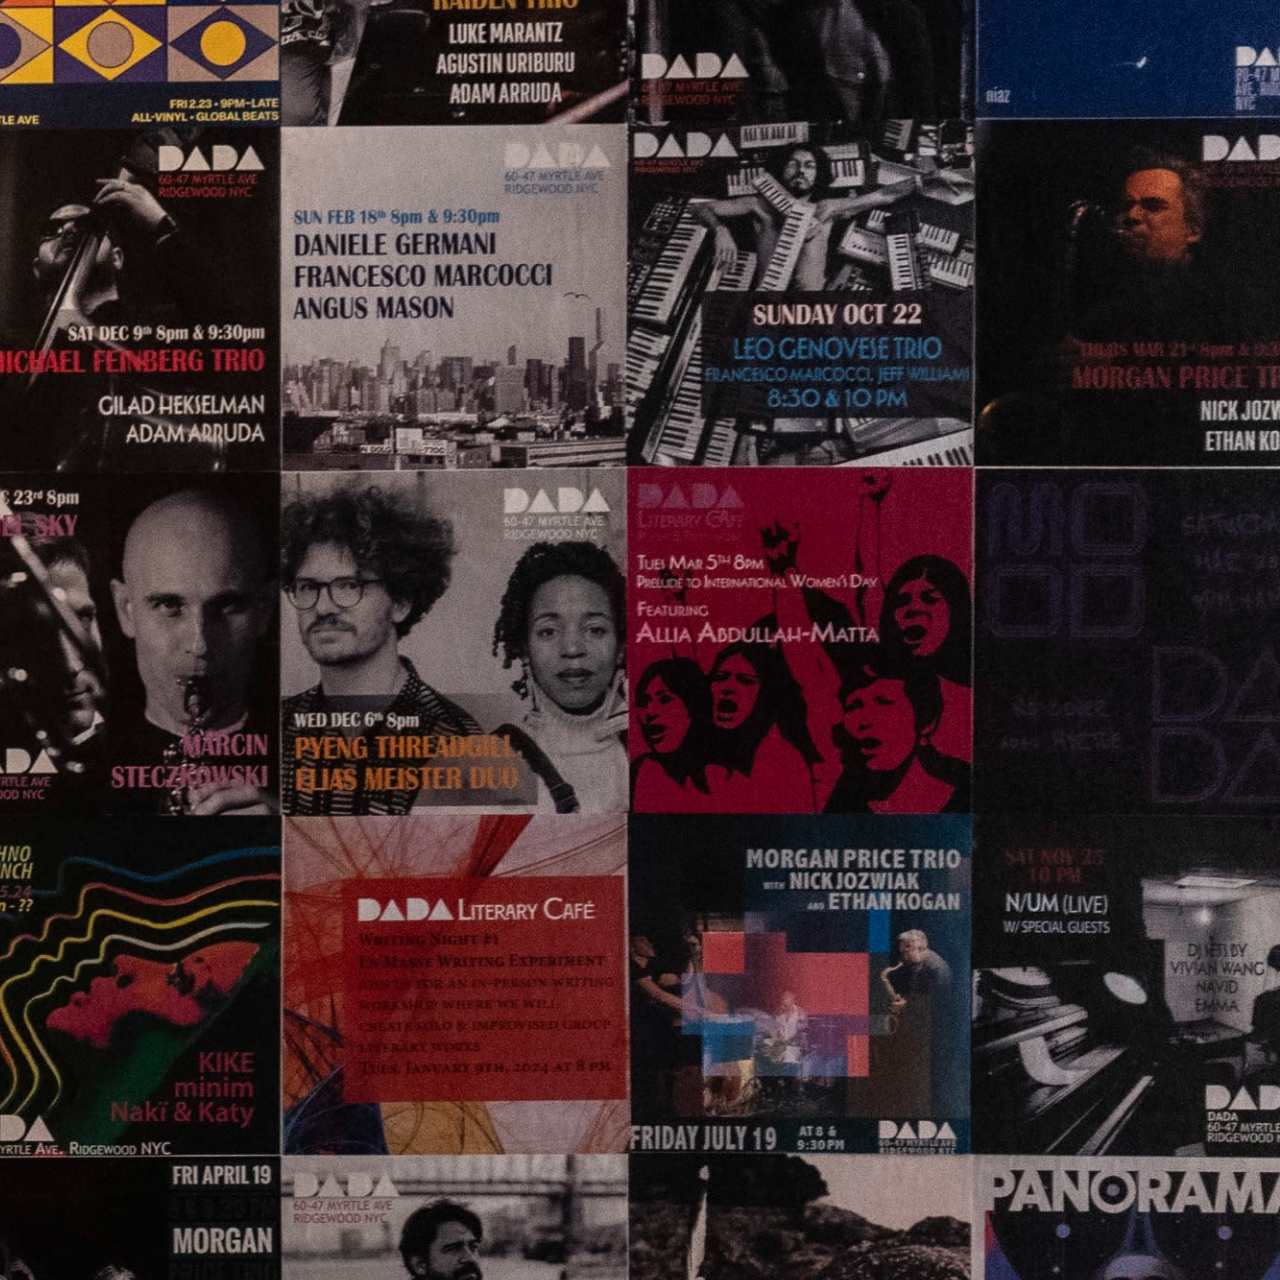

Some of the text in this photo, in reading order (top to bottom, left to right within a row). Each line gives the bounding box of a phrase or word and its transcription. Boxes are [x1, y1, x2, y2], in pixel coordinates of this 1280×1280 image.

[448, 23, 563, 44] LUKE MARANTZ
[436, 52, 575, 75] AGUSTIN URIBURU
[450, 83, 563, 105] ADAM ARRUDA
[18, 114, 40, 124] AVE
[294, 232, 496, 258] DANIELE GERMANI
[294, 263, 553, 289] FRANCESCO MARCOCCI
[294, 295, 454, 320] ANGUS MASON
[753, 304, 922, 327] SUNDAY OCT 22
[93, 349, 207, 373] FEINBERG
[212, 349, 265, 372] TRIO
[98, 395, 265, 416] GILAD HEKSELMAN
[112, 764, 267, 790] STECZKOWSKI
[747, 849, 962, 869] MORGAN PRICE TRIO
[173, 1165, 272, 1186] FRI APRIL 19
